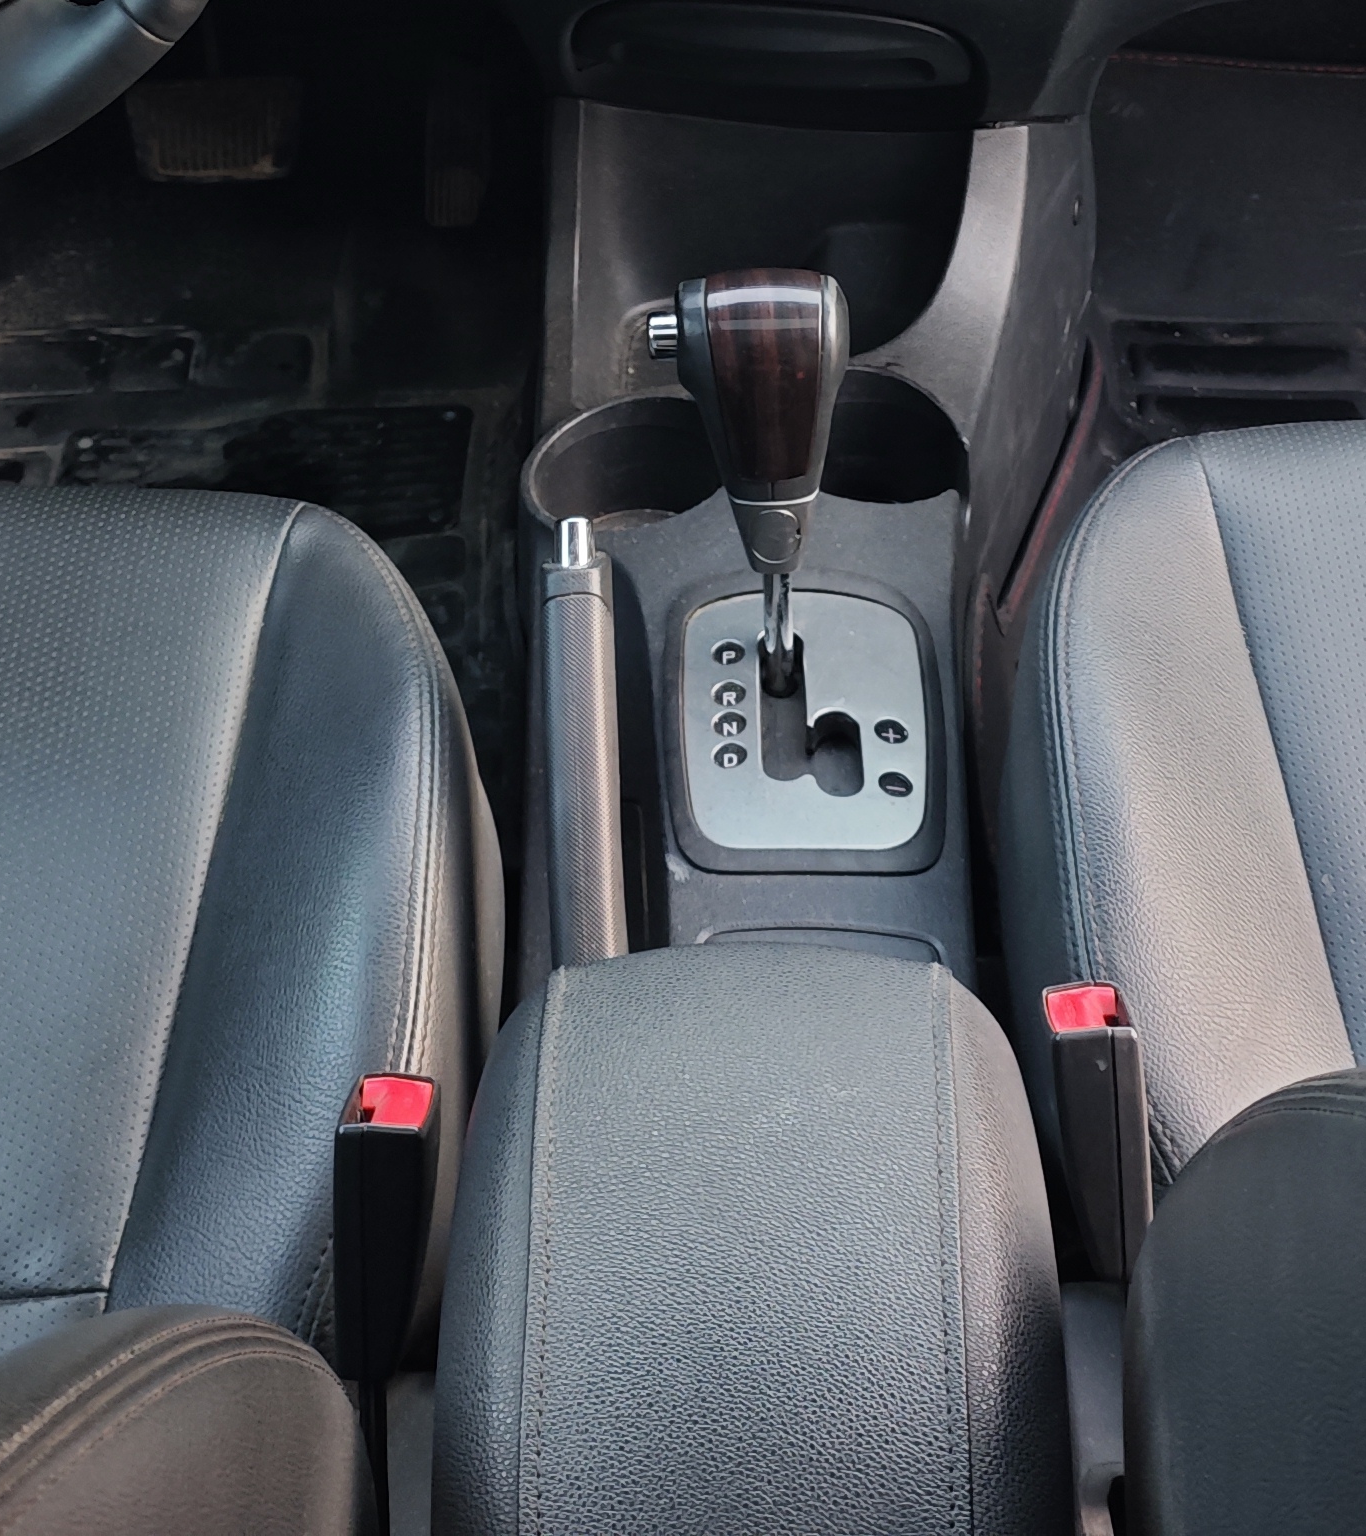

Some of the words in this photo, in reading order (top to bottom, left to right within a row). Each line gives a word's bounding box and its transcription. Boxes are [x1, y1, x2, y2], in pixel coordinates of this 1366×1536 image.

[722, 650, 736, 665] P
[722, 691, 737, 706] R
[723, 721, 738, 737] N
[723, 753, 738, 768] D
